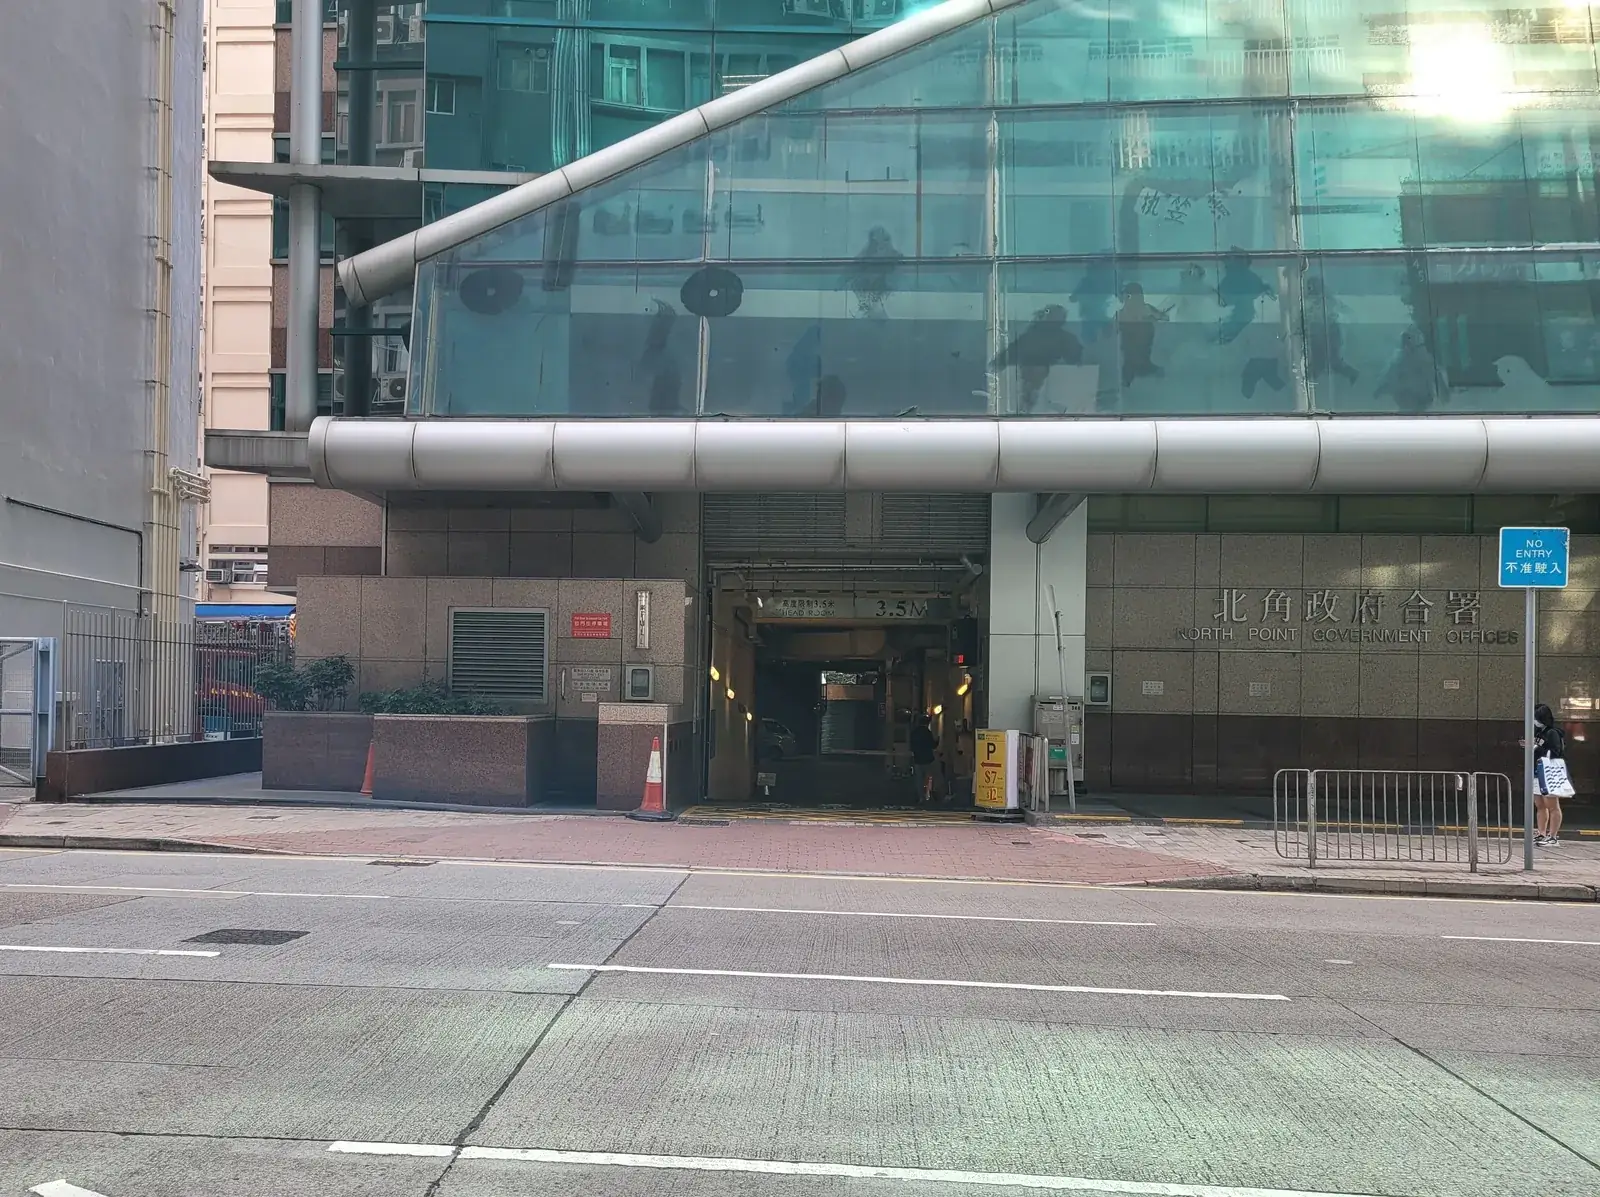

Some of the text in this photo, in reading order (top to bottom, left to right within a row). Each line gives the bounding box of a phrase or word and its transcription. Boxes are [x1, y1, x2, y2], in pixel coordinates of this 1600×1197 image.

[1526, 539, 1543, 548] NO
[1515, 549, 1553, 558] ENTRY
[1505, 562, 1562, 574] 不准駛入
[782, 609, 835, 617] HEAD ROOM
[875, 599, 928, 617] 3.5M
[1213, 589, 1482, 624] 北角政府合署
[1176, 627, 1519, 644] NORTH POINT GOVERNMENT OFFICES
[987, 742, 997, 761] P
